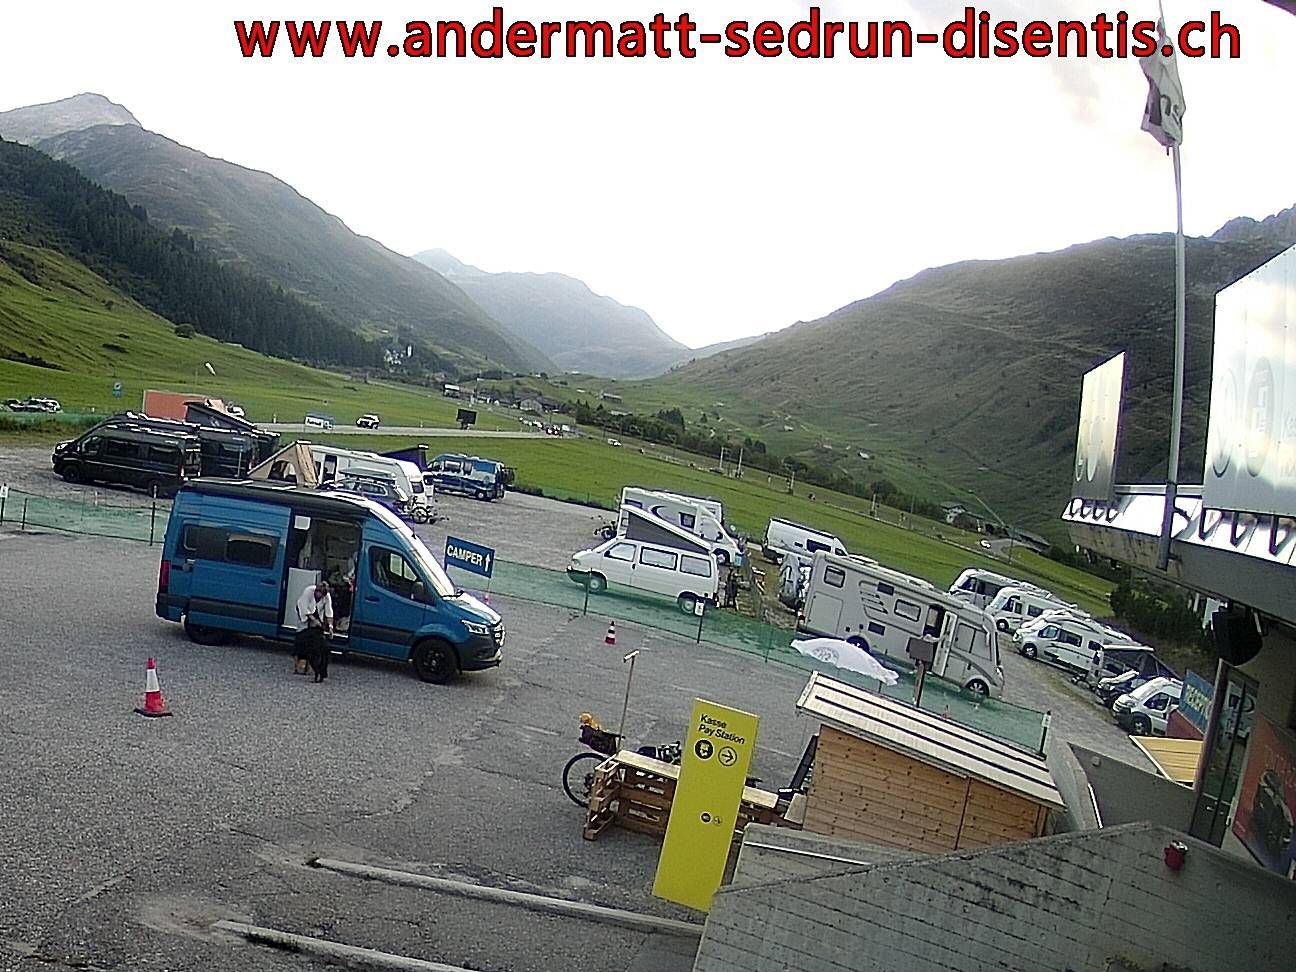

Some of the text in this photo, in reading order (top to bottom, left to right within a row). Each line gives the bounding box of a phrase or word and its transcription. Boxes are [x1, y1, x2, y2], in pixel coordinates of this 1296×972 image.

[447, 544, 483, 567] CAMPER
[700, 713, 727, 729] Kasse
[698, 723, 745, 745] Pay Station
